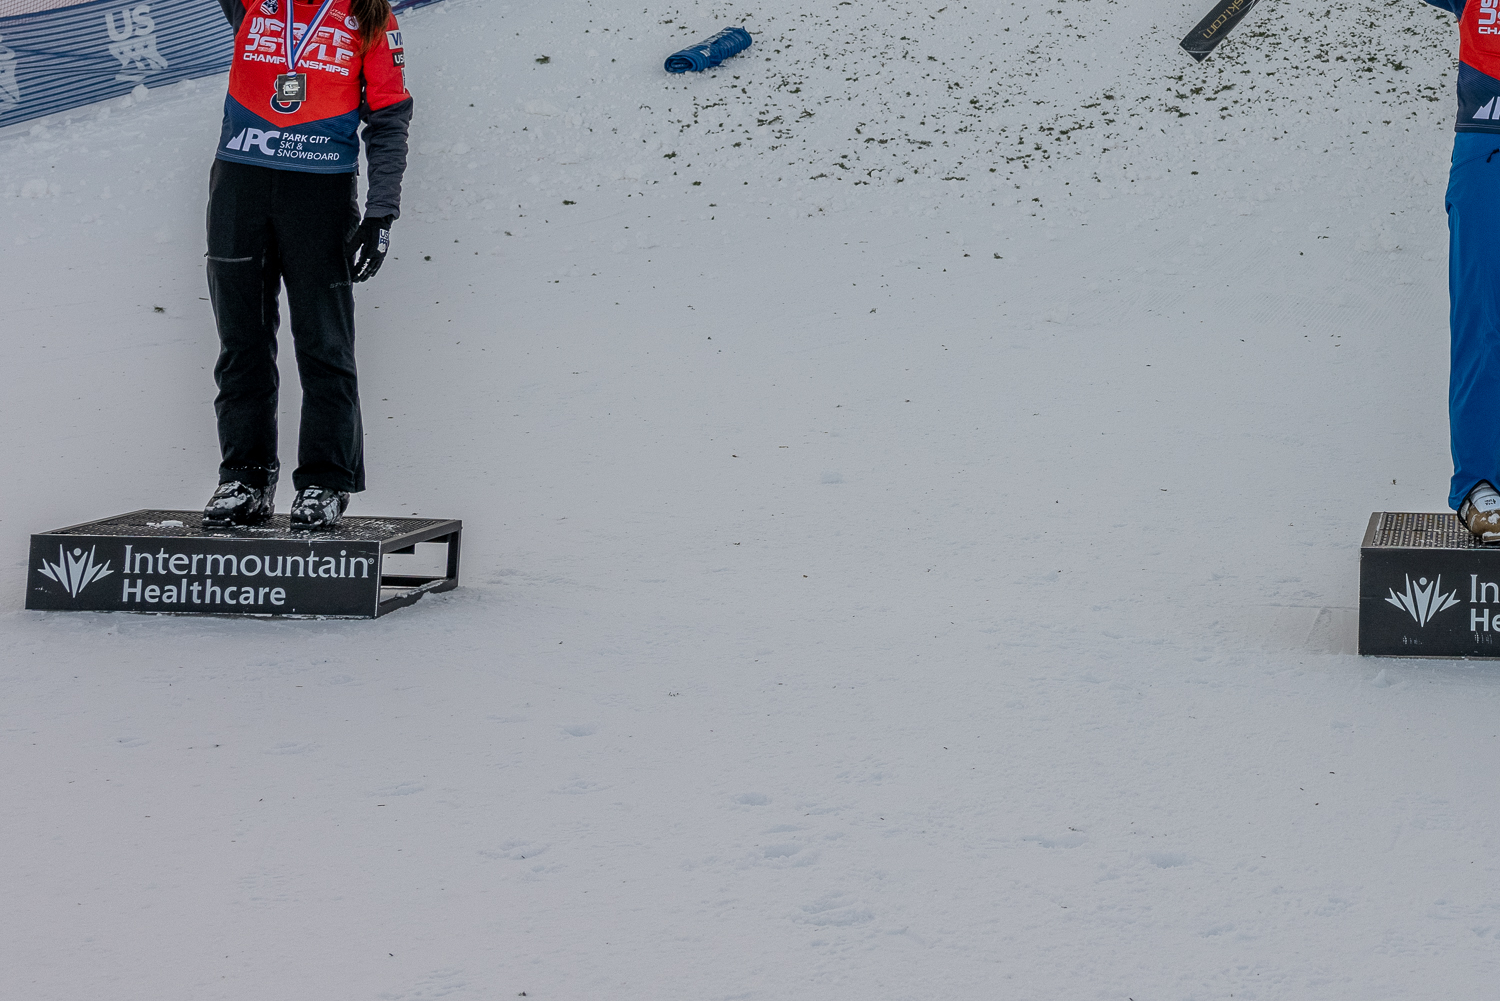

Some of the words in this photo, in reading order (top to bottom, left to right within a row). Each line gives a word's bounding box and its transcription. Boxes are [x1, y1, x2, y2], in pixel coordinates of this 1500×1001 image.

[105, 4, 155, 41] US
[243, 53, 349, 76] CHAMPNSHIPS
[280, 141, 294, 149] SKI
[282, 132, 308, 142] PARK
[309, 136, 331, 144] CITY
[277, 149, 340, 160] SNOWBOARD
[122, 578, 286, 605] Healthcare
